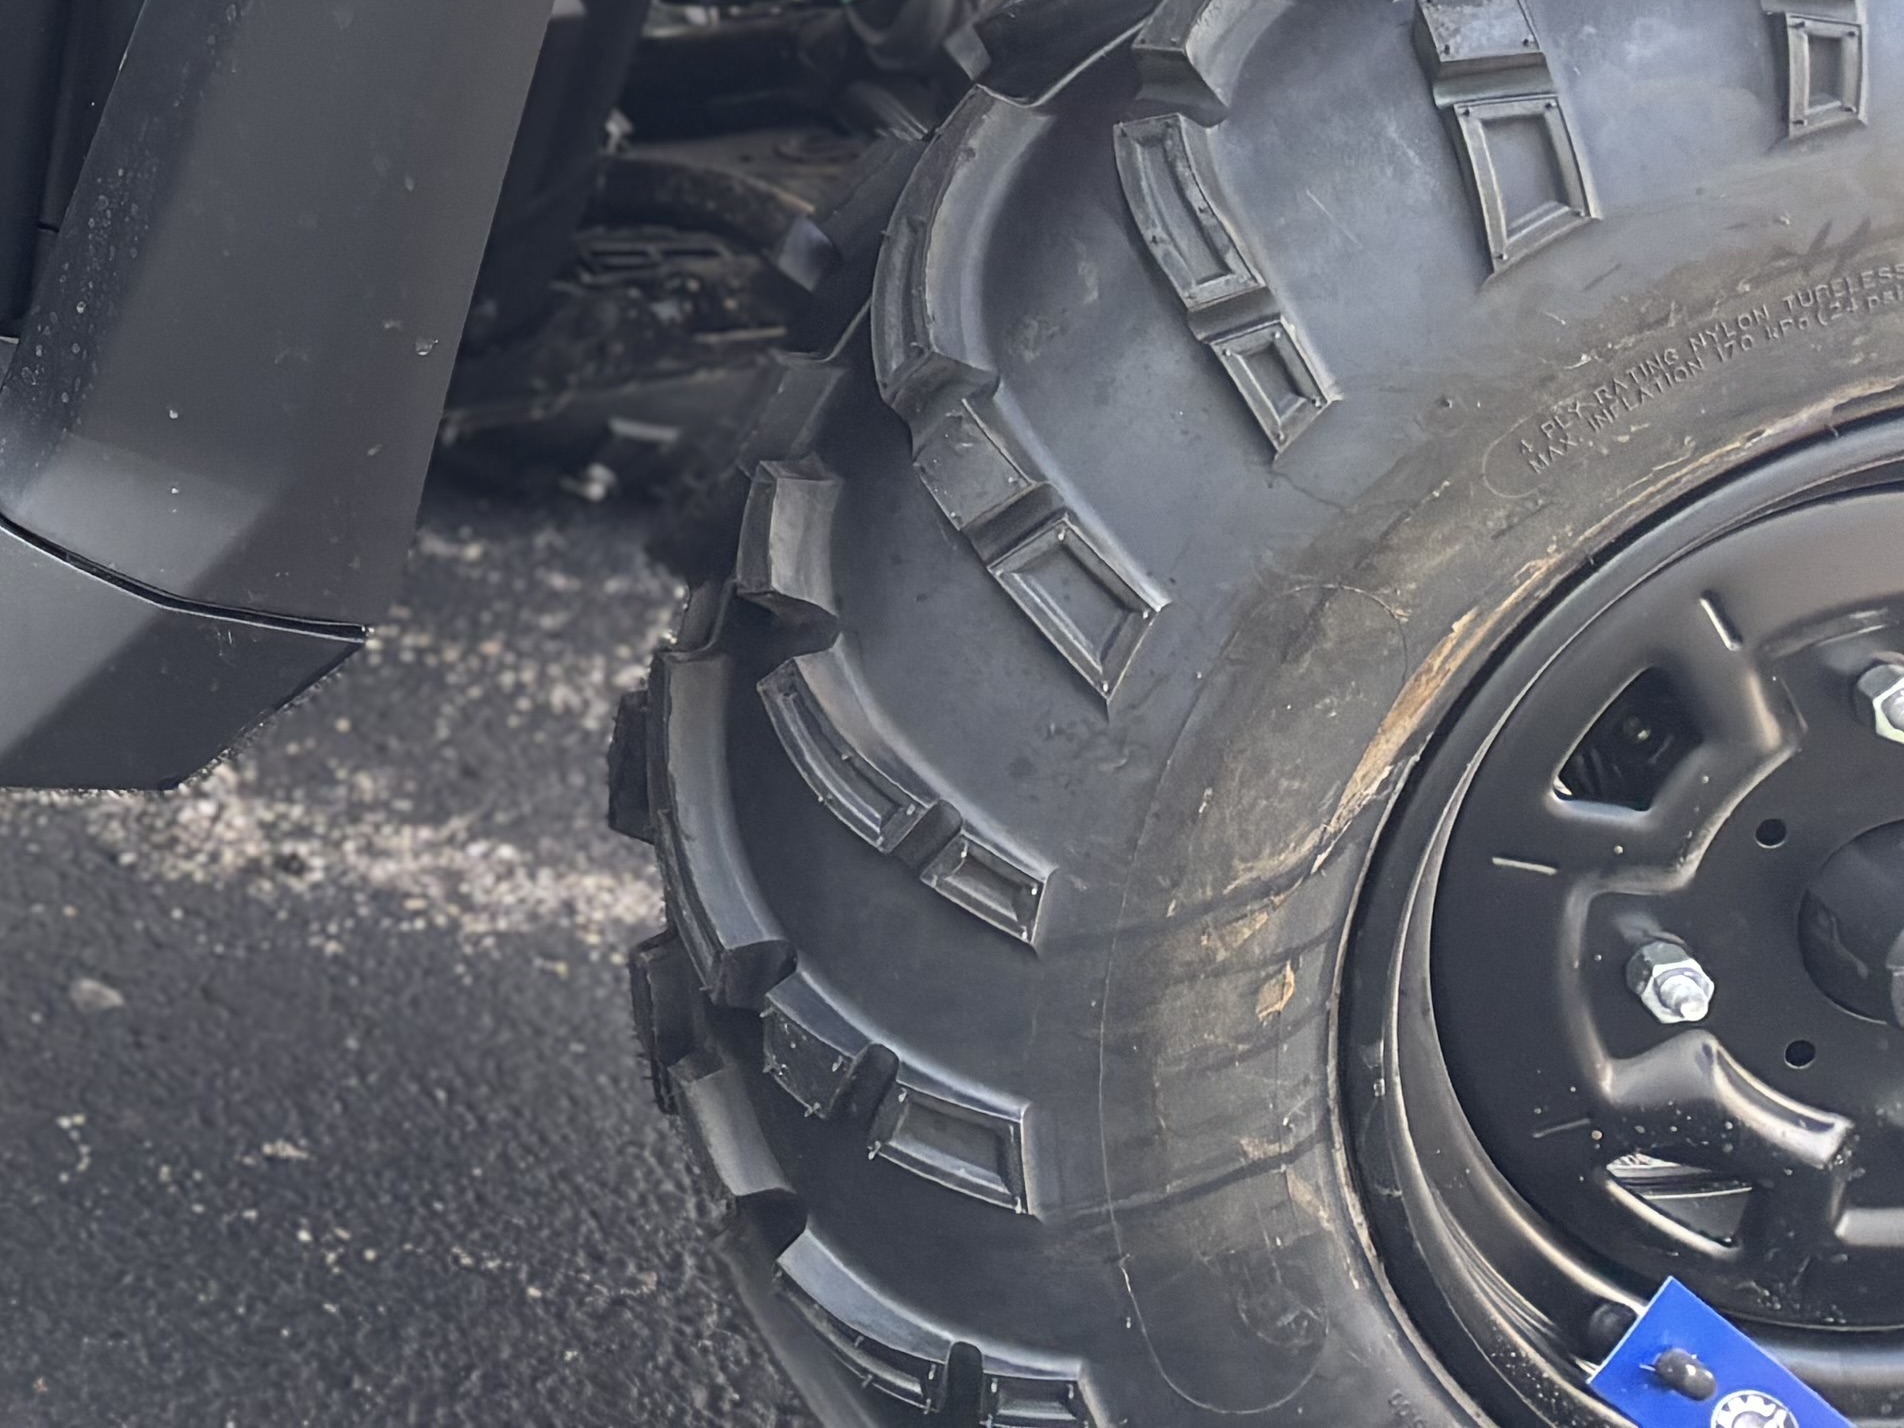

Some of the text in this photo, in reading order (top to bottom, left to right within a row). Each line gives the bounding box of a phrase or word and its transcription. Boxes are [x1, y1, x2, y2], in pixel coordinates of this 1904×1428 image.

[1588, 356, 1704, 433] INFLATION
[1716, 334, 1754, 363] 170
[1593, 347, 1680, 404] RATING
[1688, 305, 1771, 351] NYLON
